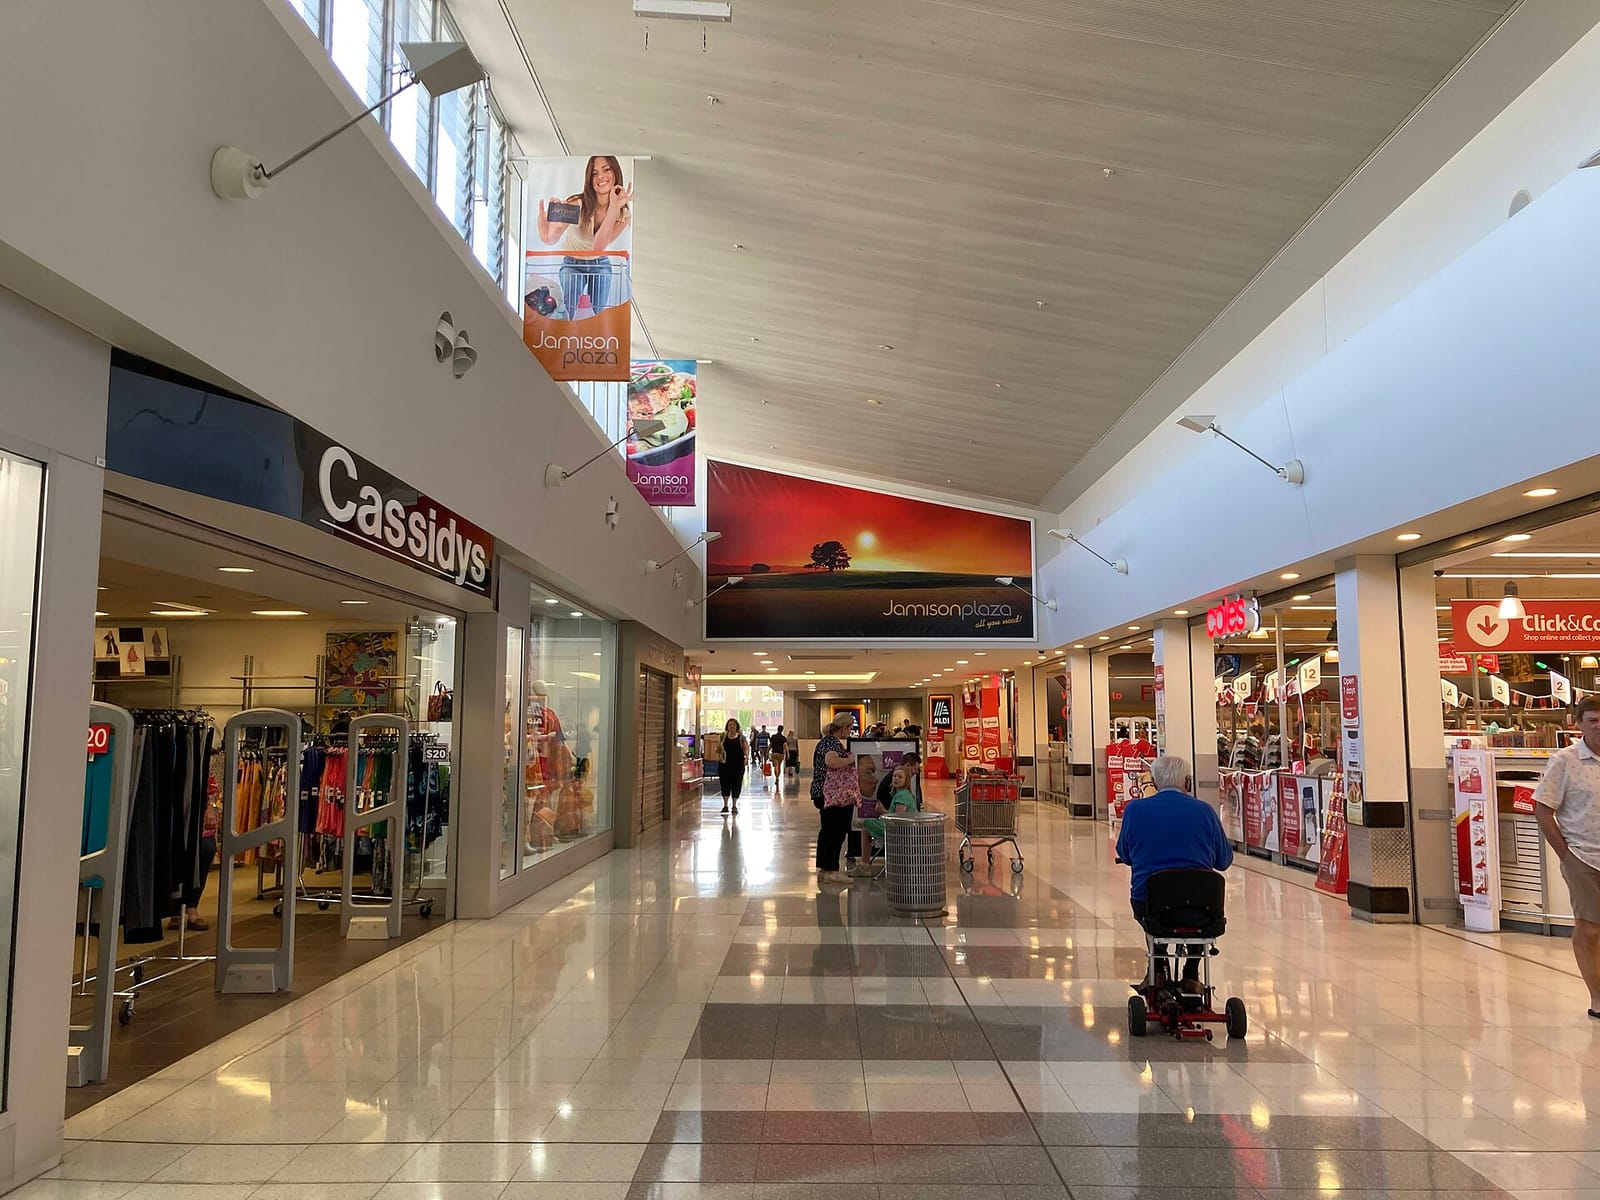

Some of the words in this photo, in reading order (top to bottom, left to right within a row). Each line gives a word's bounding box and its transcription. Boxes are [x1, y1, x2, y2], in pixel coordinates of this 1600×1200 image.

[532, 330, 619, 349] Jamison
[563, 348, 618, 369] plaza
[632, 472, 688, 485] Jamison
[652, 484, 688, 497] plaza
[318, 446, 486, 586] Cassidys
[882, 599, 1012, 621] Jamisonplaza
[1206, 594, 1246, 638] coles
[975, 618, 986, 628] all
[986, 620, 1001, 629] you
[1002, 614, 1023, 625] need!
[1523, 634, 1539, 642] Shop
[1303, 668, 1316, 679] 12
[1236, 682, 1247, 691] 10
[1446, 688, 1453, 697] 4
[1497, 685, 1504, 695] 3
[1556, 682, 1564, 691] 2
[1111, 691, 1122, 700] to
[934, 717, 950, 725] ALDI
